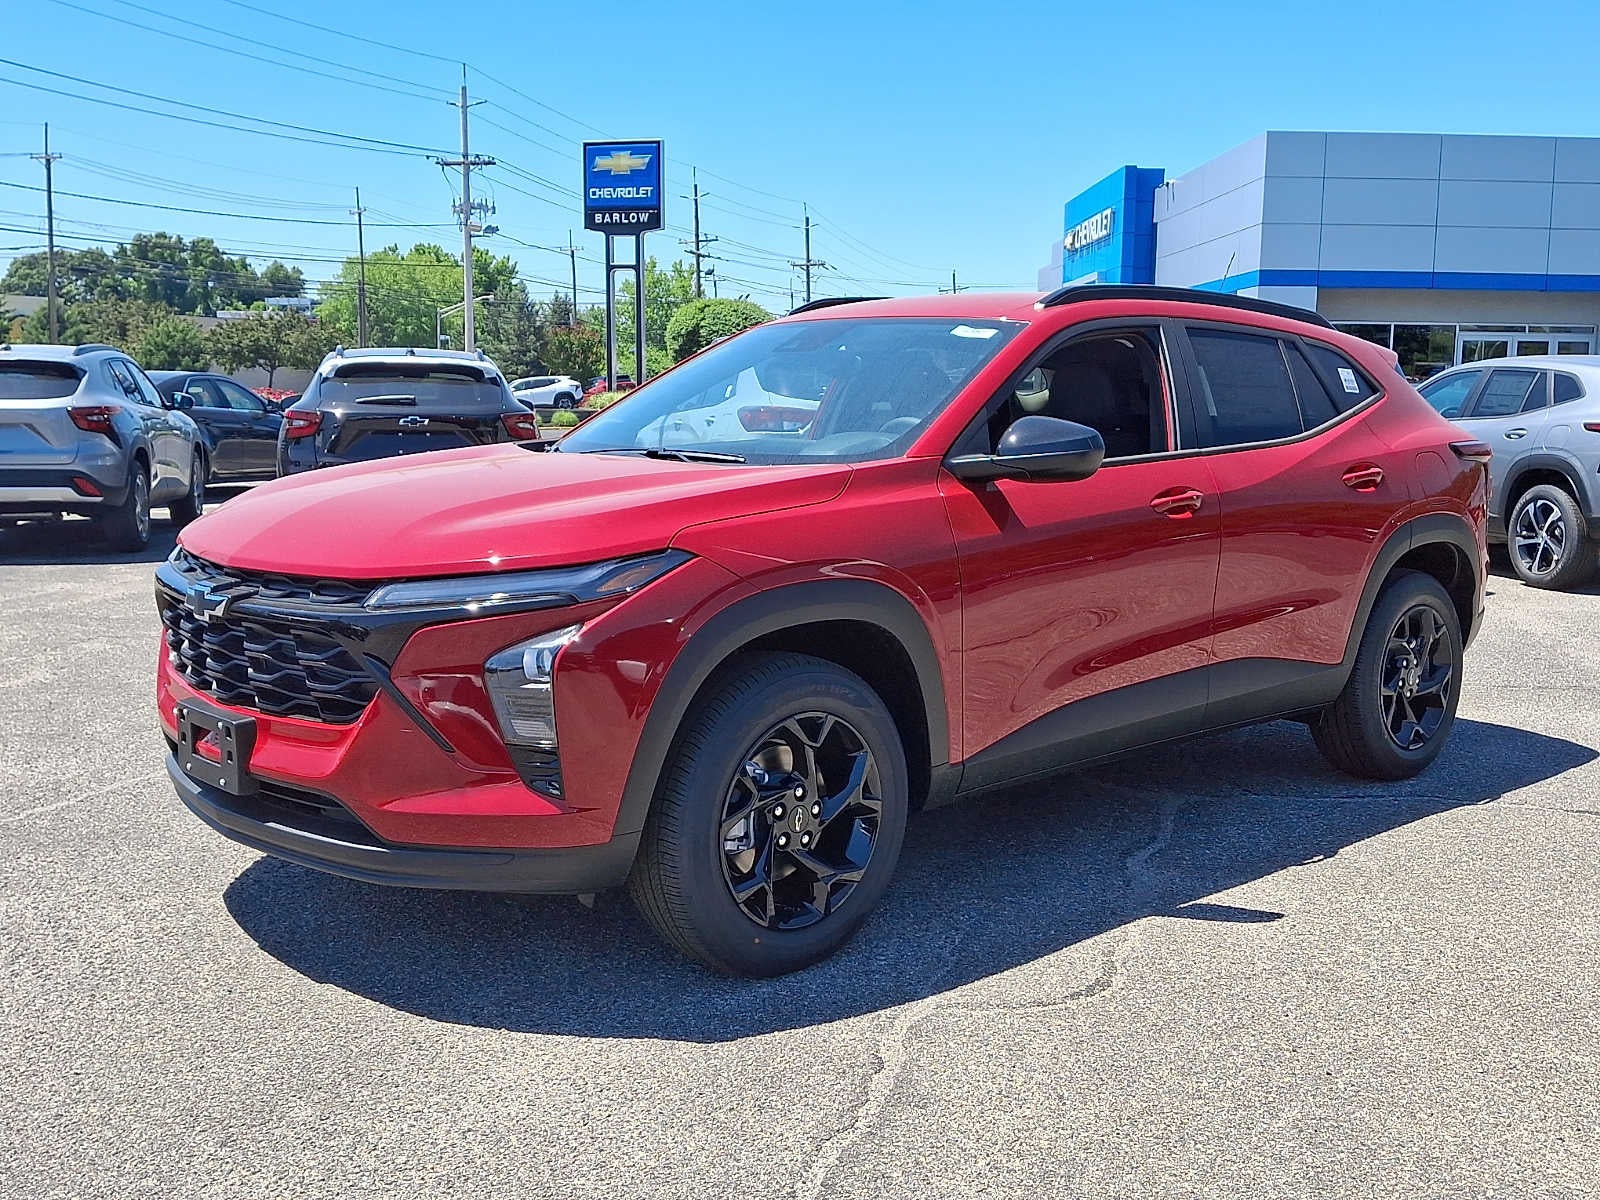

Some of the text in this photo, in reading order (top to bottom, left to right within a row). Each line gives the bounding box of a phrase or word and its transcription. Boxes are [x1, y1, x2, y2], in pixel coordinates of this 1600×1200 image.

[589, 186, 653, 198] CHEVROLET
[594, 212, 649, 223] BARLOW
[1074, 207, 1112, 248] CHEVROLET
